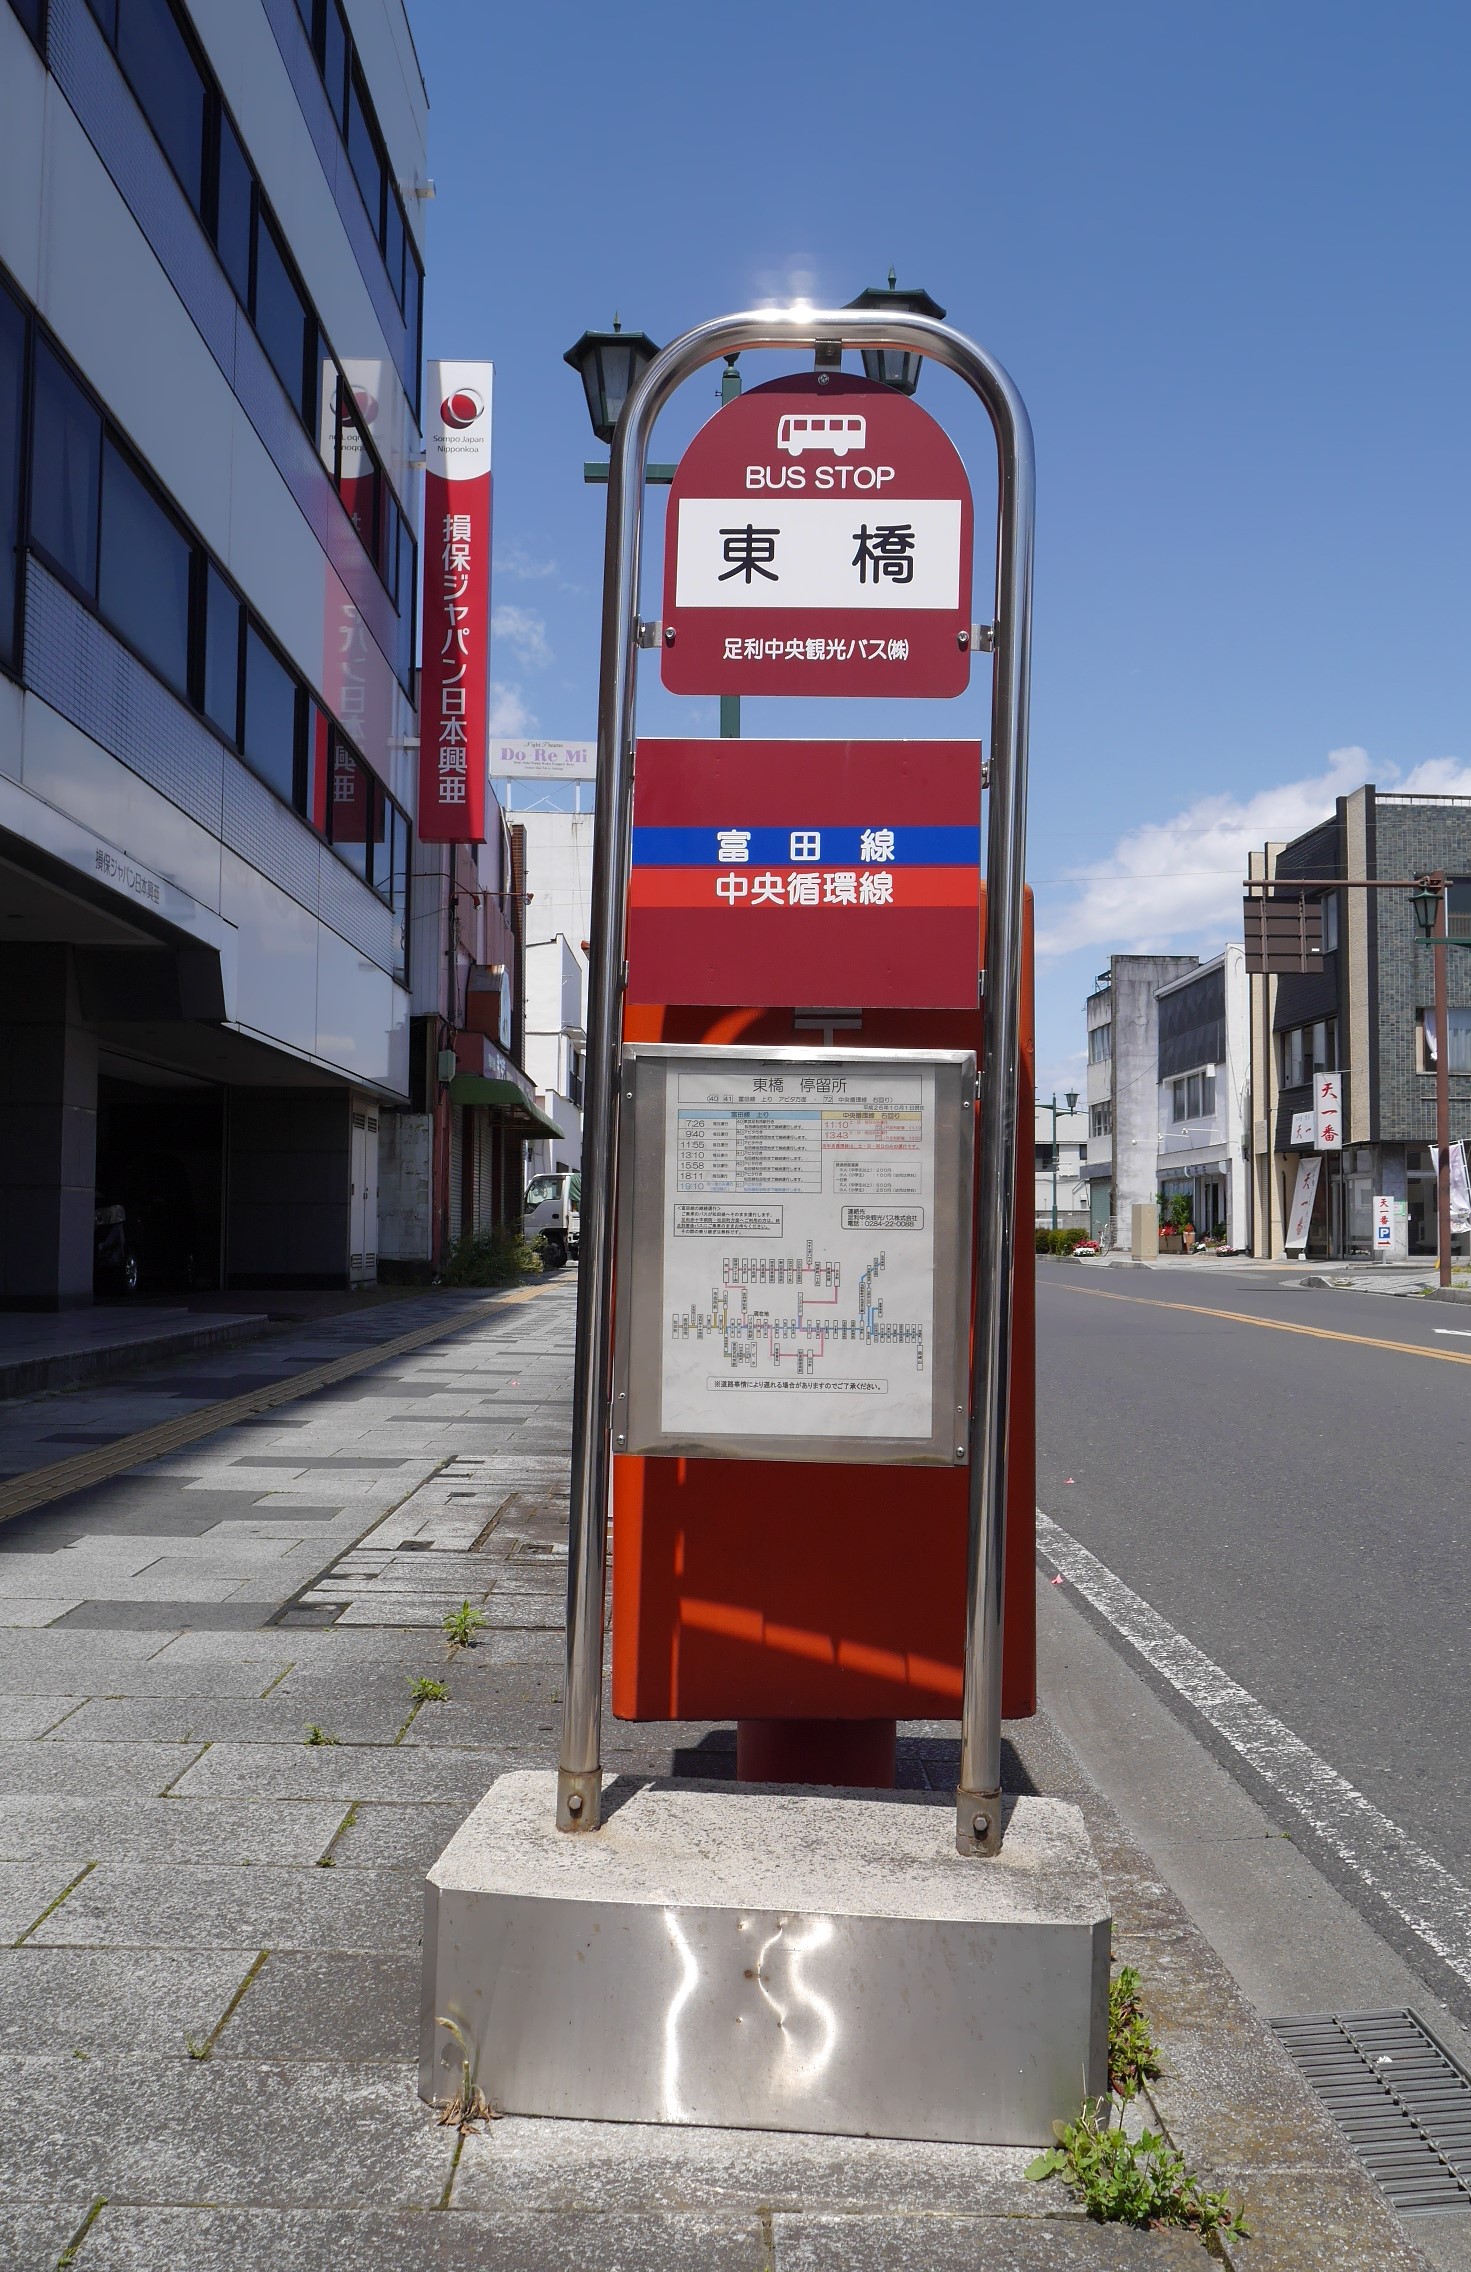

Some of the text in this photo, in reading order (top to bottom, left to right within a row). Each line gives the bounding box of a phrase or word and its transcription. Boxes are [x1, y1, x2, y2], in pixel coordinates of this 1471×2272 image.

[433, 435, 484, 444] Sompo Japan
[437, 445, 479, 453] Nipponkoa
[745, 465, 895, 489] BUS STOP
[717, 523, 915, 584] 東橋
[438, 514, 471, 804] 損保ジャパン日本興亜
[500, 747, 588, 763] Do Re Mi
[716, 828, 896, 863] 富田線
[95, 847, 160, 905] 損保ジャパン日本興亜
[715, 871, 894, 906] 中央循環線
[752, 1077, 847, 1094] 東橋 停留所
[1321, 1083, 1338, 1141] 天一番
[685, 1120, 705, 1128] 7:26
[680, 1141, 705, 1149] 11:55
[680, 1151, 705, 1159] 13:10
[680, 1162, 705, 1170] 15:58
[680, 1172, 704, 1180] 18:11
[680, 1182, 705, 1190] 19:10
[1380, 1198, 1389, 1225] 天一番
[714, 1380, 882, 1391] ※道路事情により遅れる場合がありますのでご了承ください。
